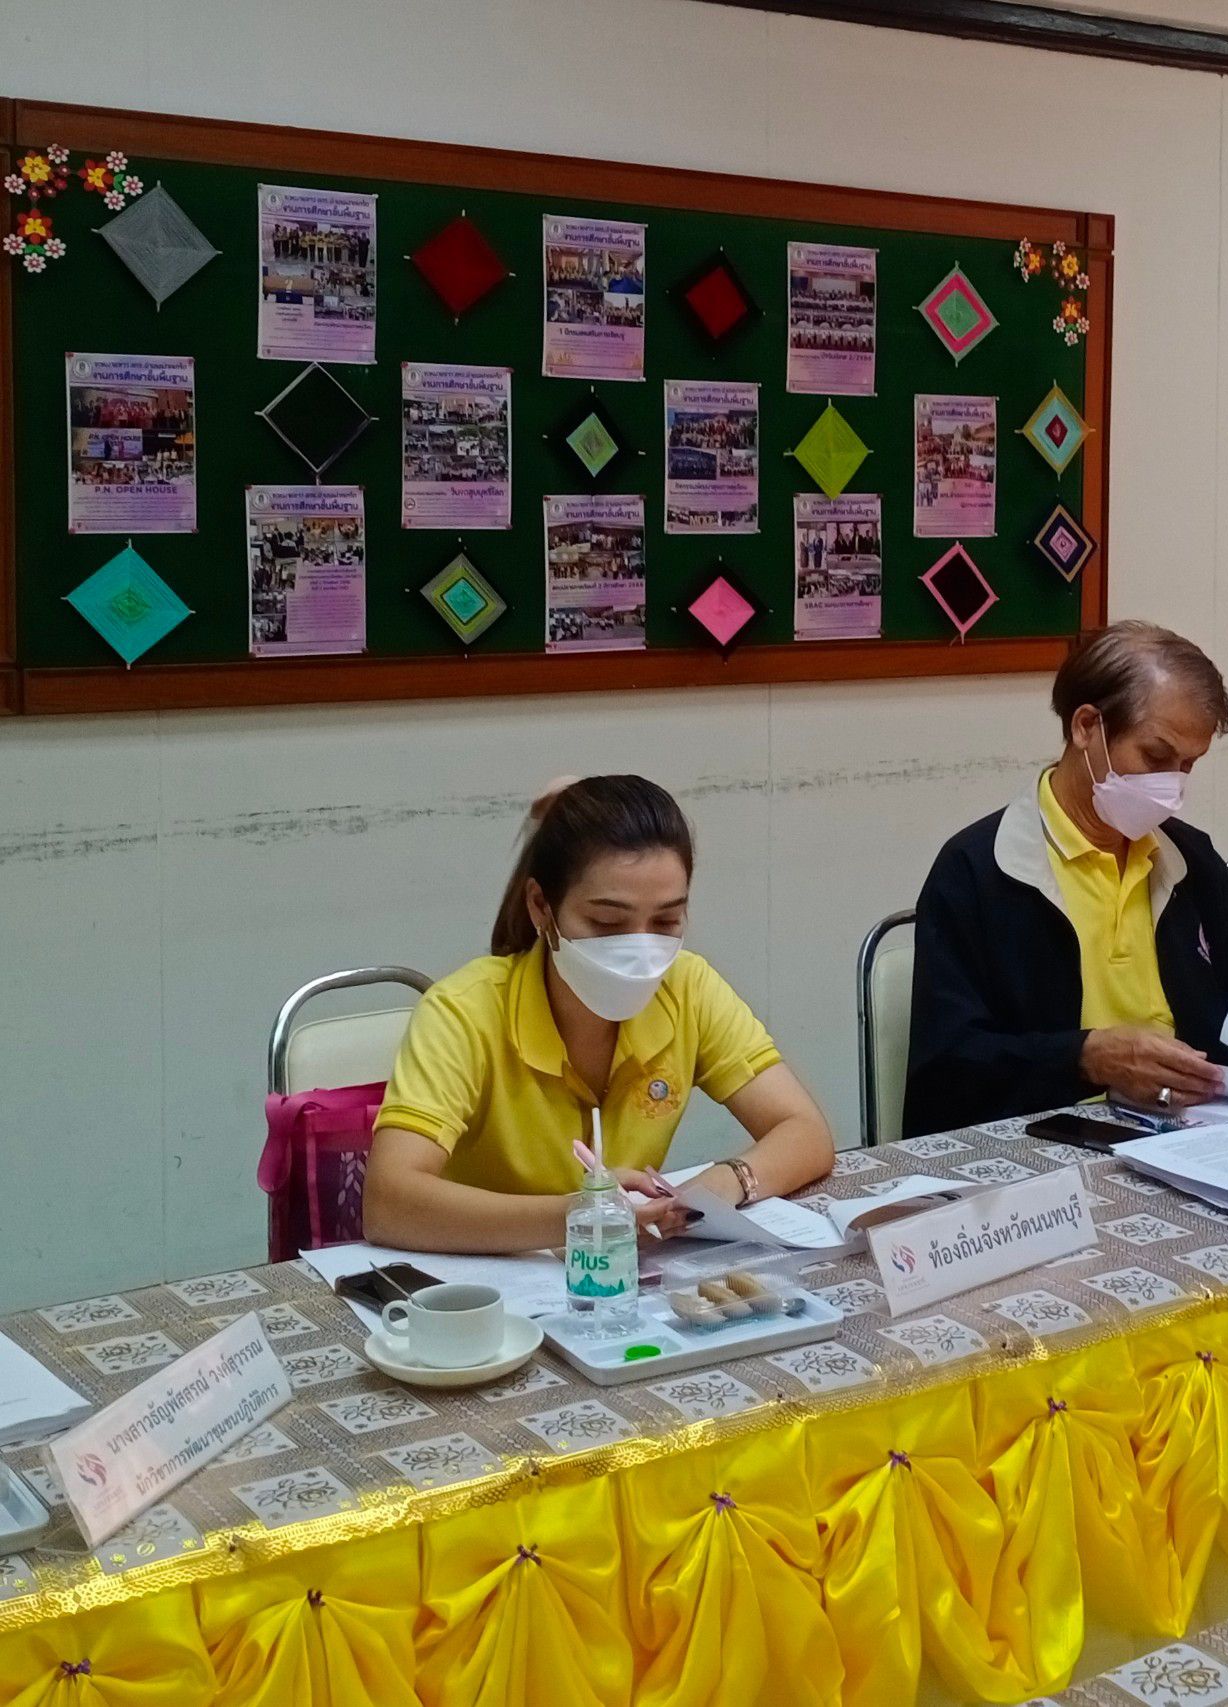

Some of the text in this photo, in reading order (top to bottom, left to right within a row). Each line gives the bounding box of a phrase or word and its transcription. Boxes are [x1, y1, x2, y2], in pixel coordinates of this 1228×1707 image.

[93, 369, 189, 385] งานการศึกษาขั้นพื้นฐาน
[115, 485, 143, 494] OPEN
[145, 485, 178, 494] HOUSE
[926, 1193, 1084, 1272] ท้องถิ่นจังหวัดนนทบุรี
[571, 1248, 610, 1271] Plus
[135, 1380, 280, 1498] นักวิชาการพัฒนาชุมชนปฏิบัติการ
